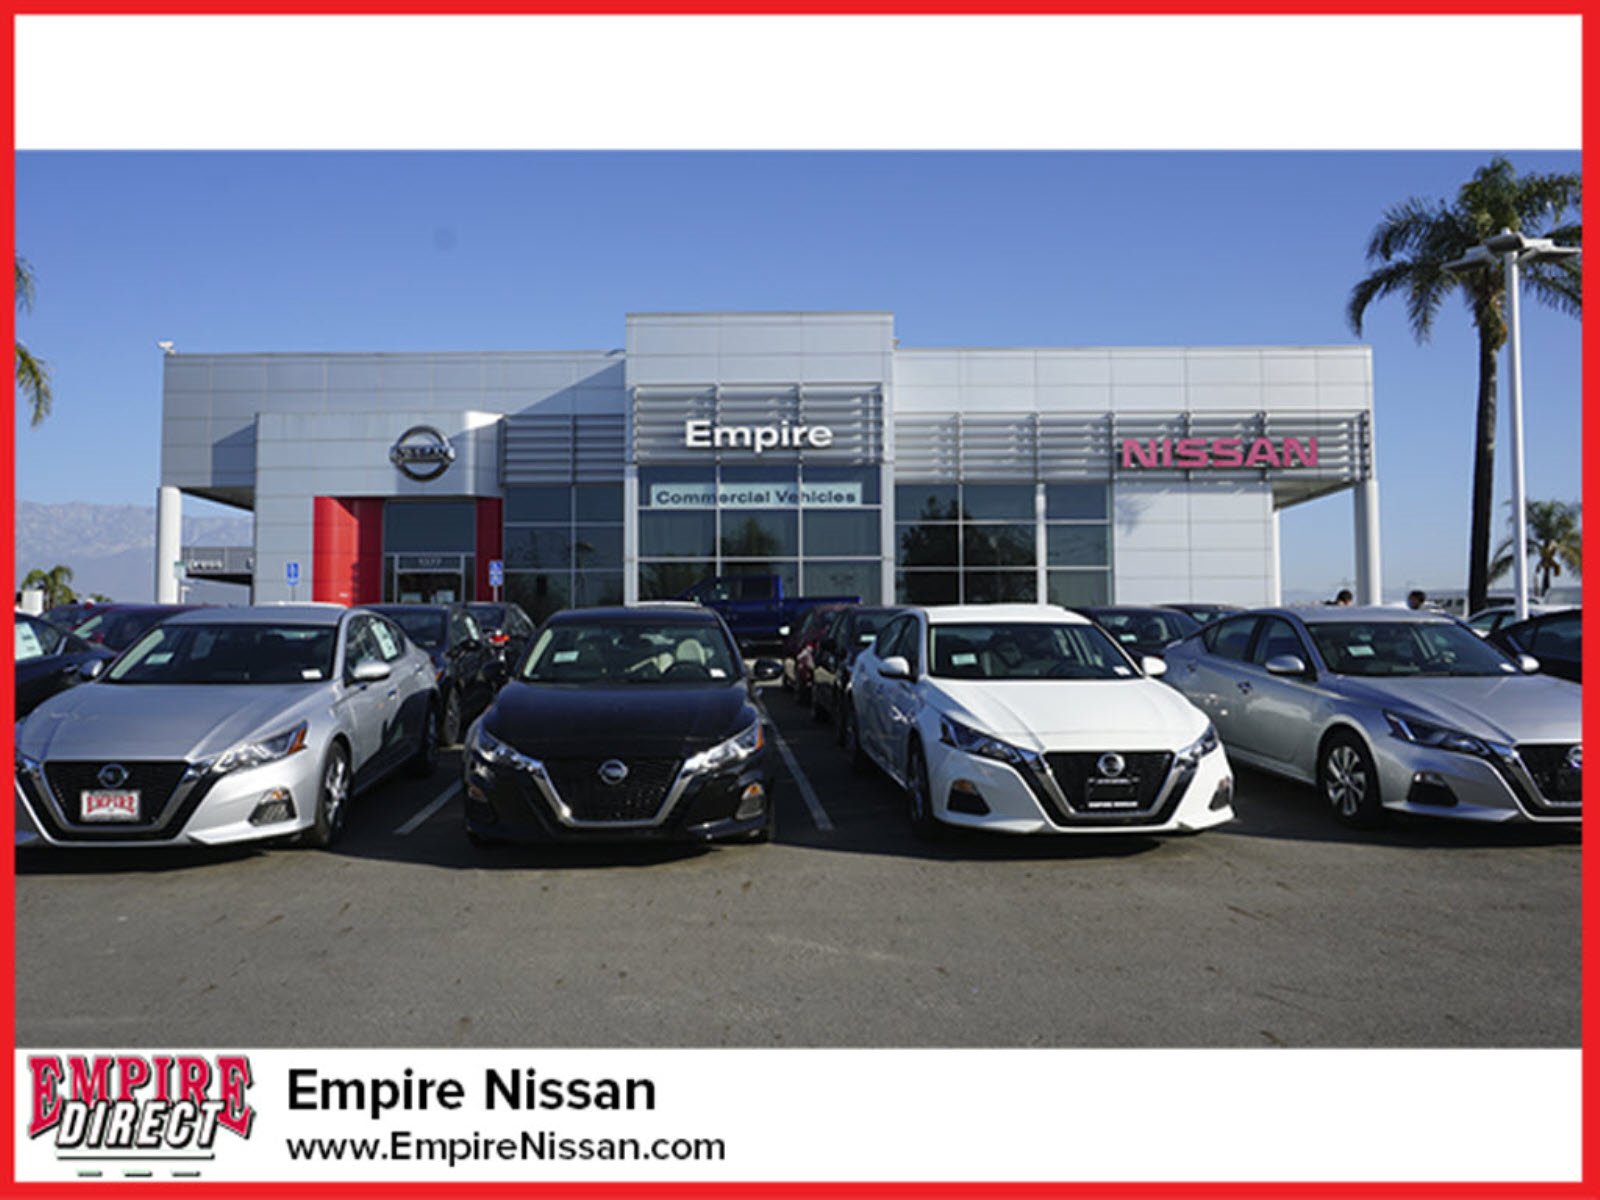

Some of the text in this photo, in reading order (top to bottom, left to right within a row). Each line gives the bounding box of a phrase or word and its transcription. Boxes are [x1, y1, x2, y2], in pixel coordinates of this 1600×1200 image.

[685, 419, 833, 453] Empire
[1121, 436, 1319, 468] NISSAN
[655, 488, 857, 505] Commercial Vehicles
